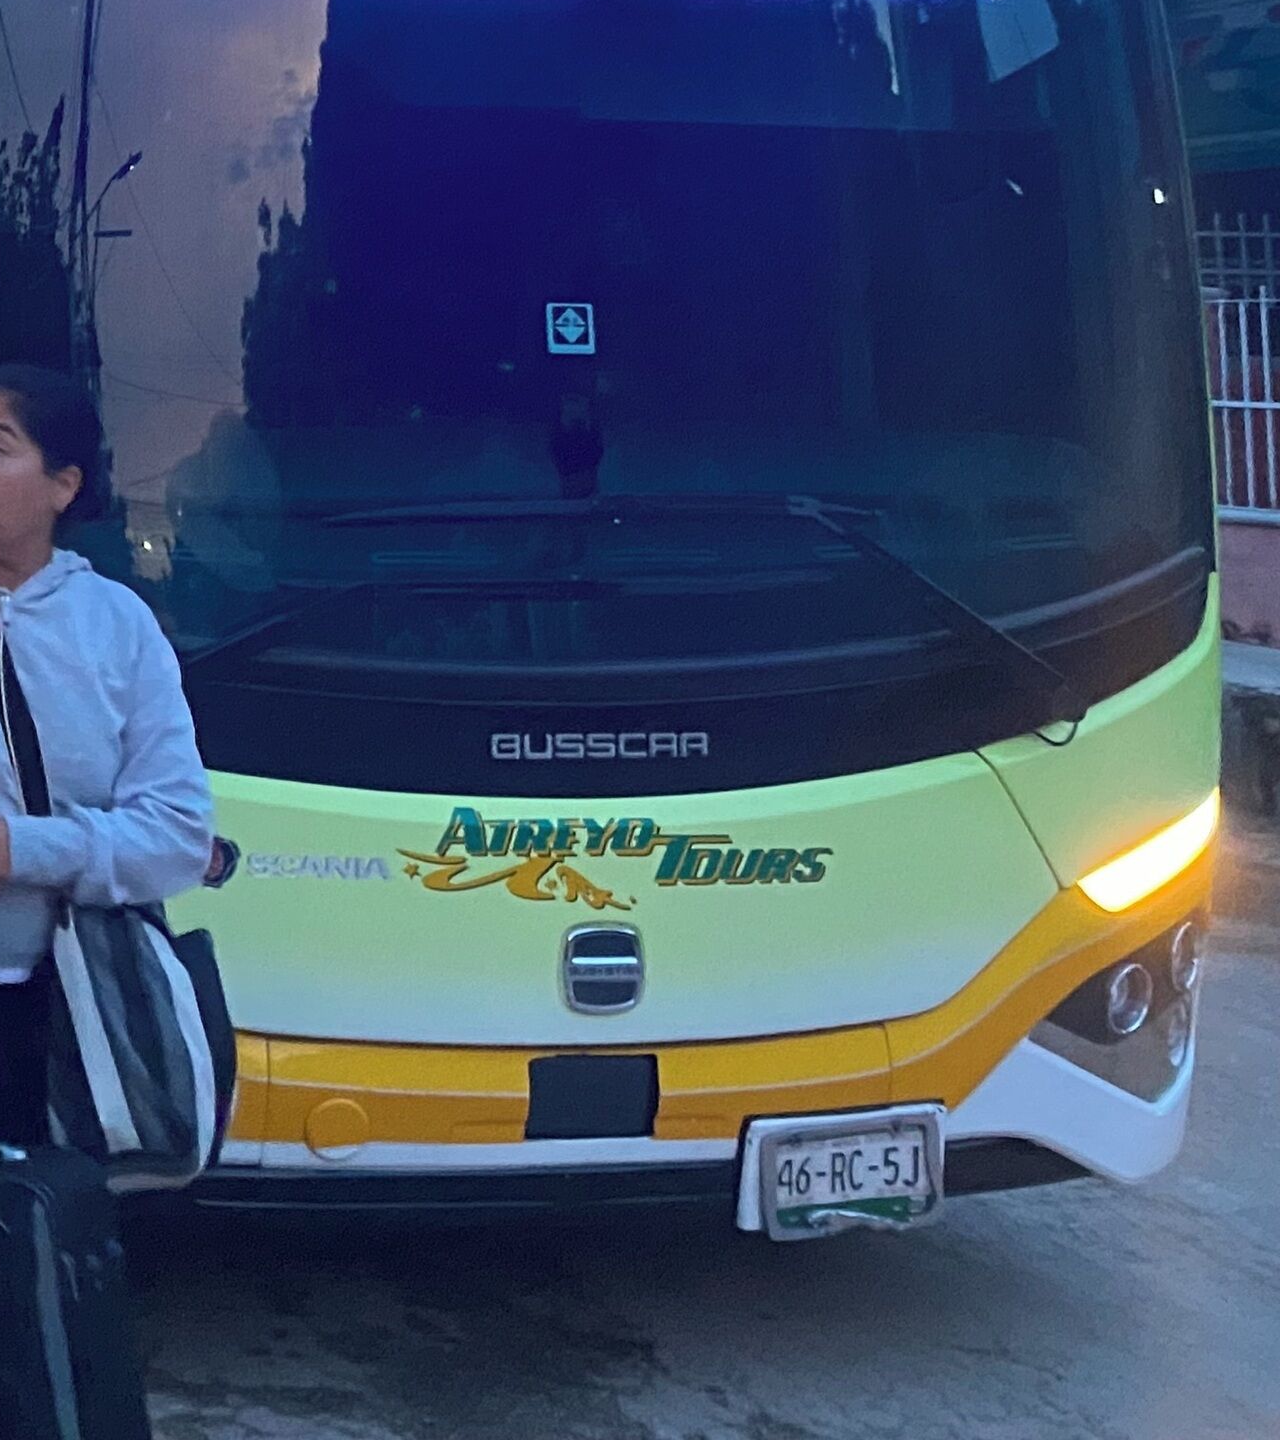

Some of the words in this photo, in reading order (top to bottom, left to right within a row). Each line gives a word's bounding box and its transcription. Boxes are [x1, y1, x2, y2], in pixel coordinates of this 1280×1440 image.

[491, 731, 709, 760] BUSSCAR
[246, 853, 392, 880] SCANIA
[652, 833, 834, 887] TOURS
